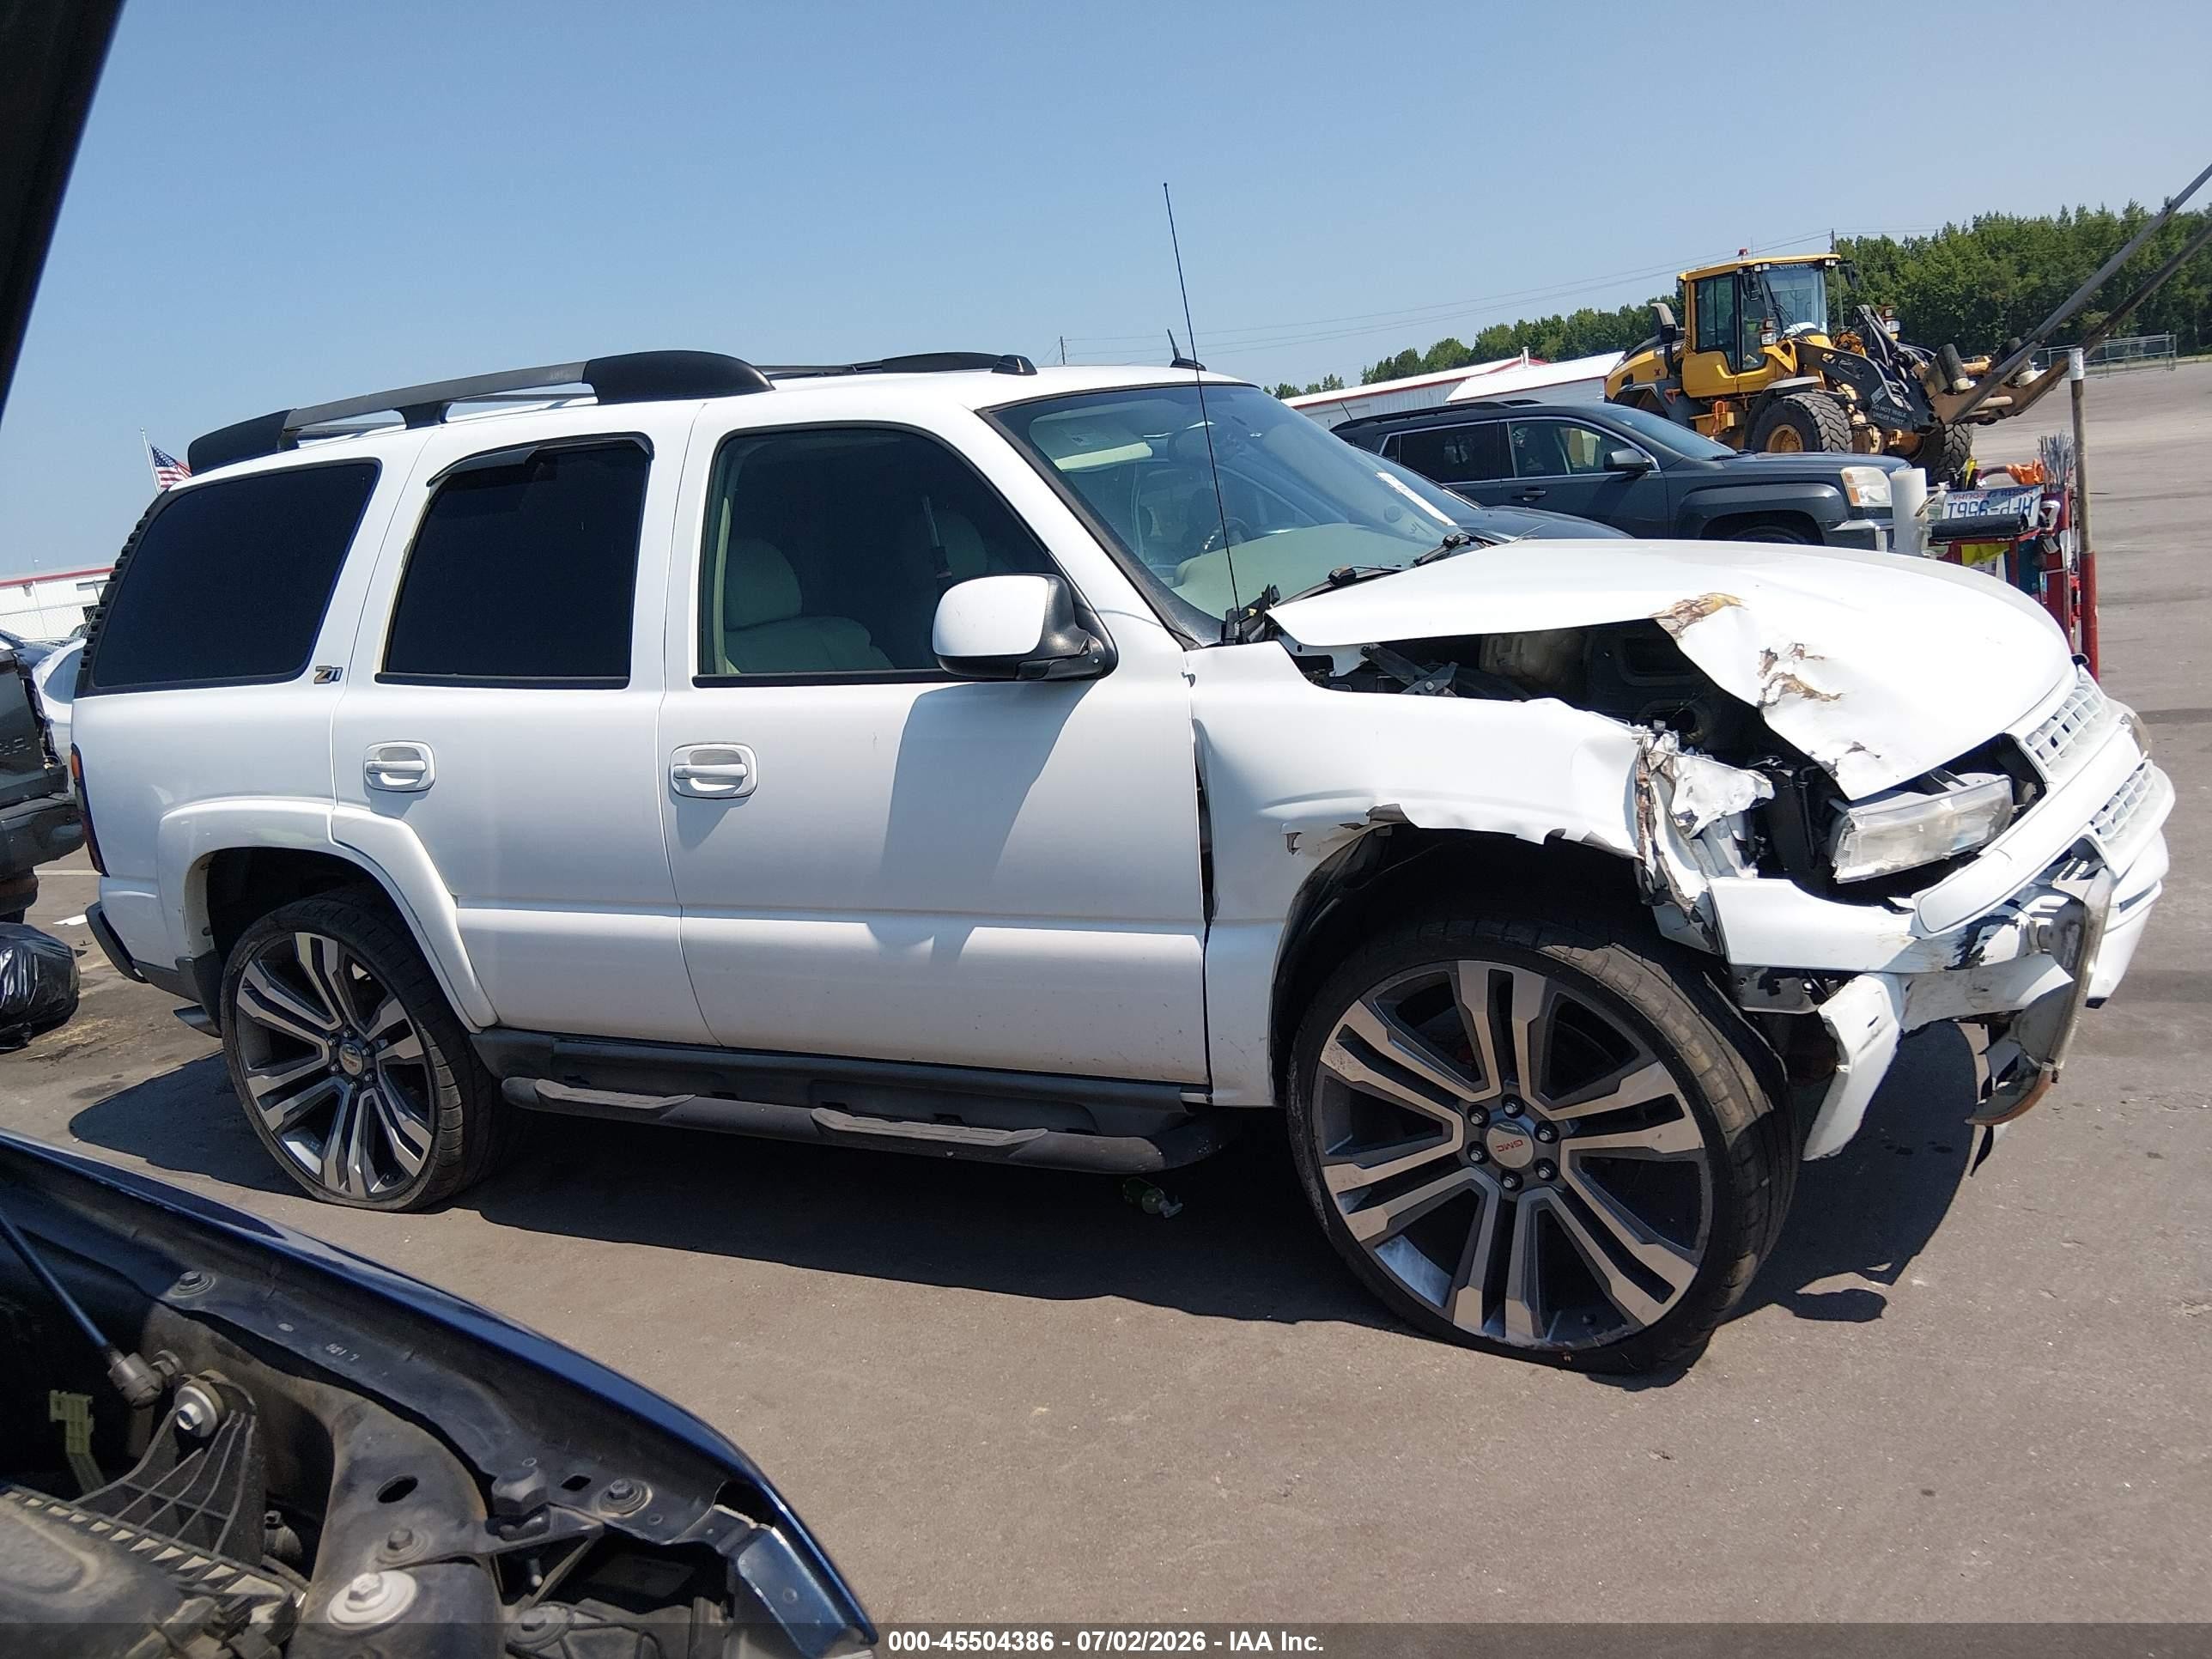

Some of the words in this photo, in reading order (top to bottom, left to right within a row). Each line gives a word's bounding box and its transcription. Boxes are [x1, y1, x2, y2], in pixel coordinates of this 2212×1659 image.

[1952, 490, 1997, 501] CAROLINA
[313, 665, 343, 684] Z71
[1495, 1139, 1524, 1152] GMC
